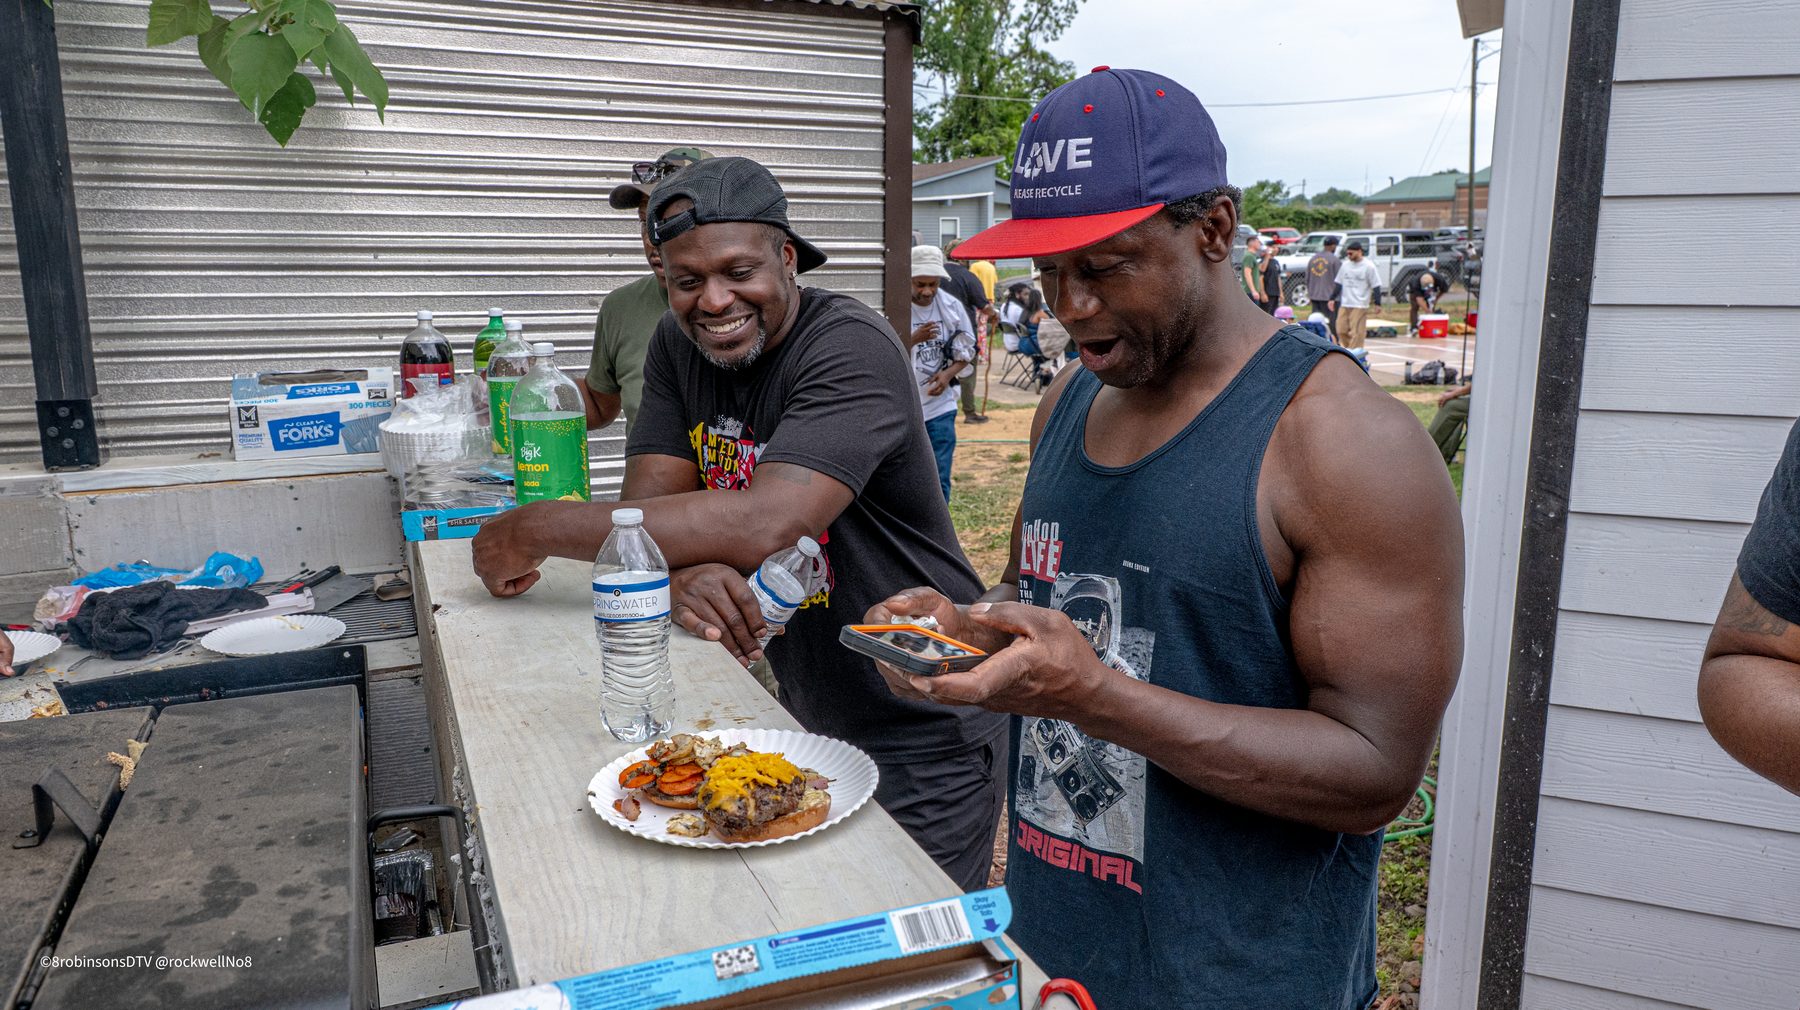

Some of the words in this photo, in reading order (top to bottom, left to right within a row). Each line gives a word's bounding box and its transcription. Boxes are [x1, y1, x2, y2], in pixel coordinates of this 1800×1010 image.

[1035, 184, 1082, 199] RECYCLE
[348, 401, 363, 410] 300
[365, 400, 392, 409] PIECES
[278, 424, 335, 443] FORKS
[517, 462, 550, 472] lemon
[1019, 579, 1028, 589] TO
[971, 902, 997, 911] Closed
